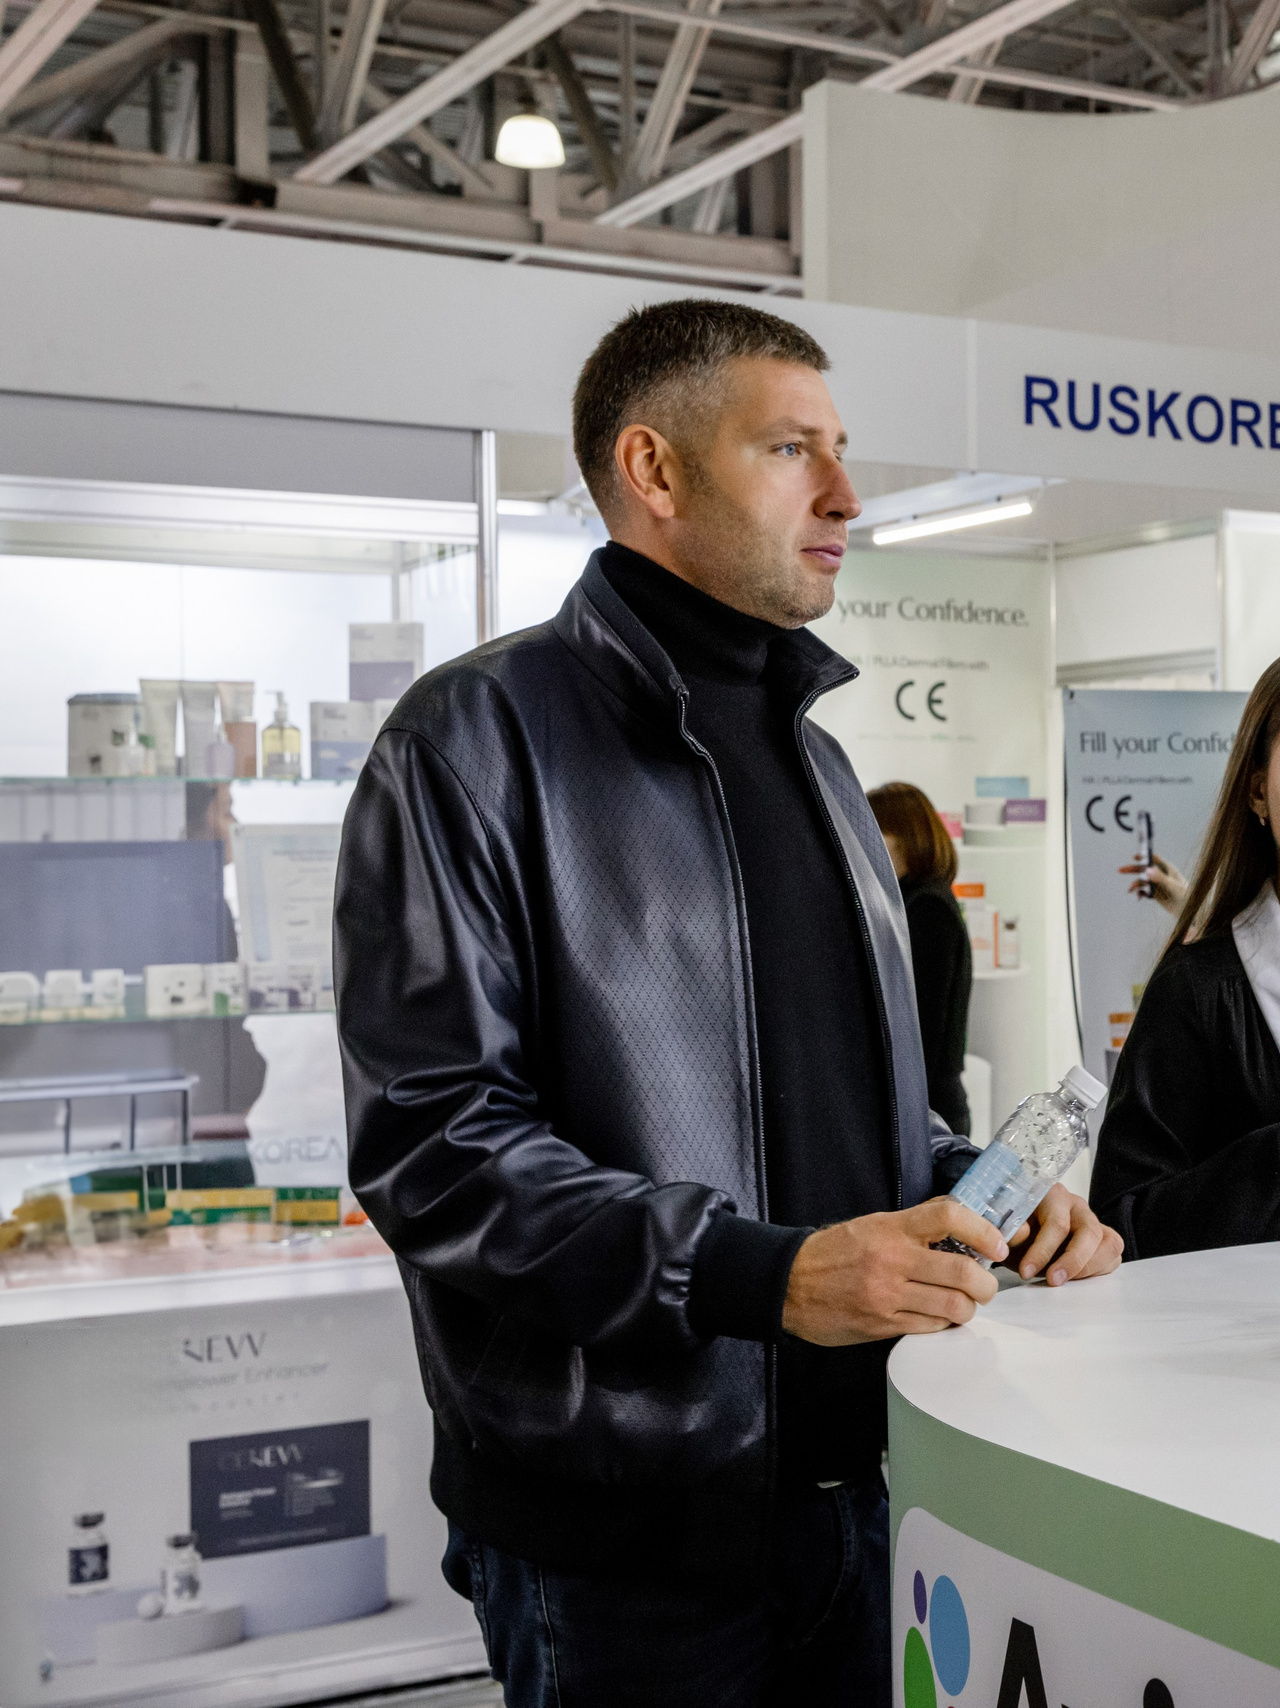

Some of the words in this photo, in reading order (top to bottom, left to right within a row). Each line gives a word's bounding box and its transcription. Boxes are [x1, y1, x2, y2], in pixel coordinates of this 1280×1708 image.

[837, 599, 891, 625] your
[897, 597, 1029, 627] Confidence.
[895, 680, 947, 721] CE
[1080, 731, 1107, 754] Fill
[1112, 737, 1161, 760] your
[1085, 794, 1134, 833] CE
